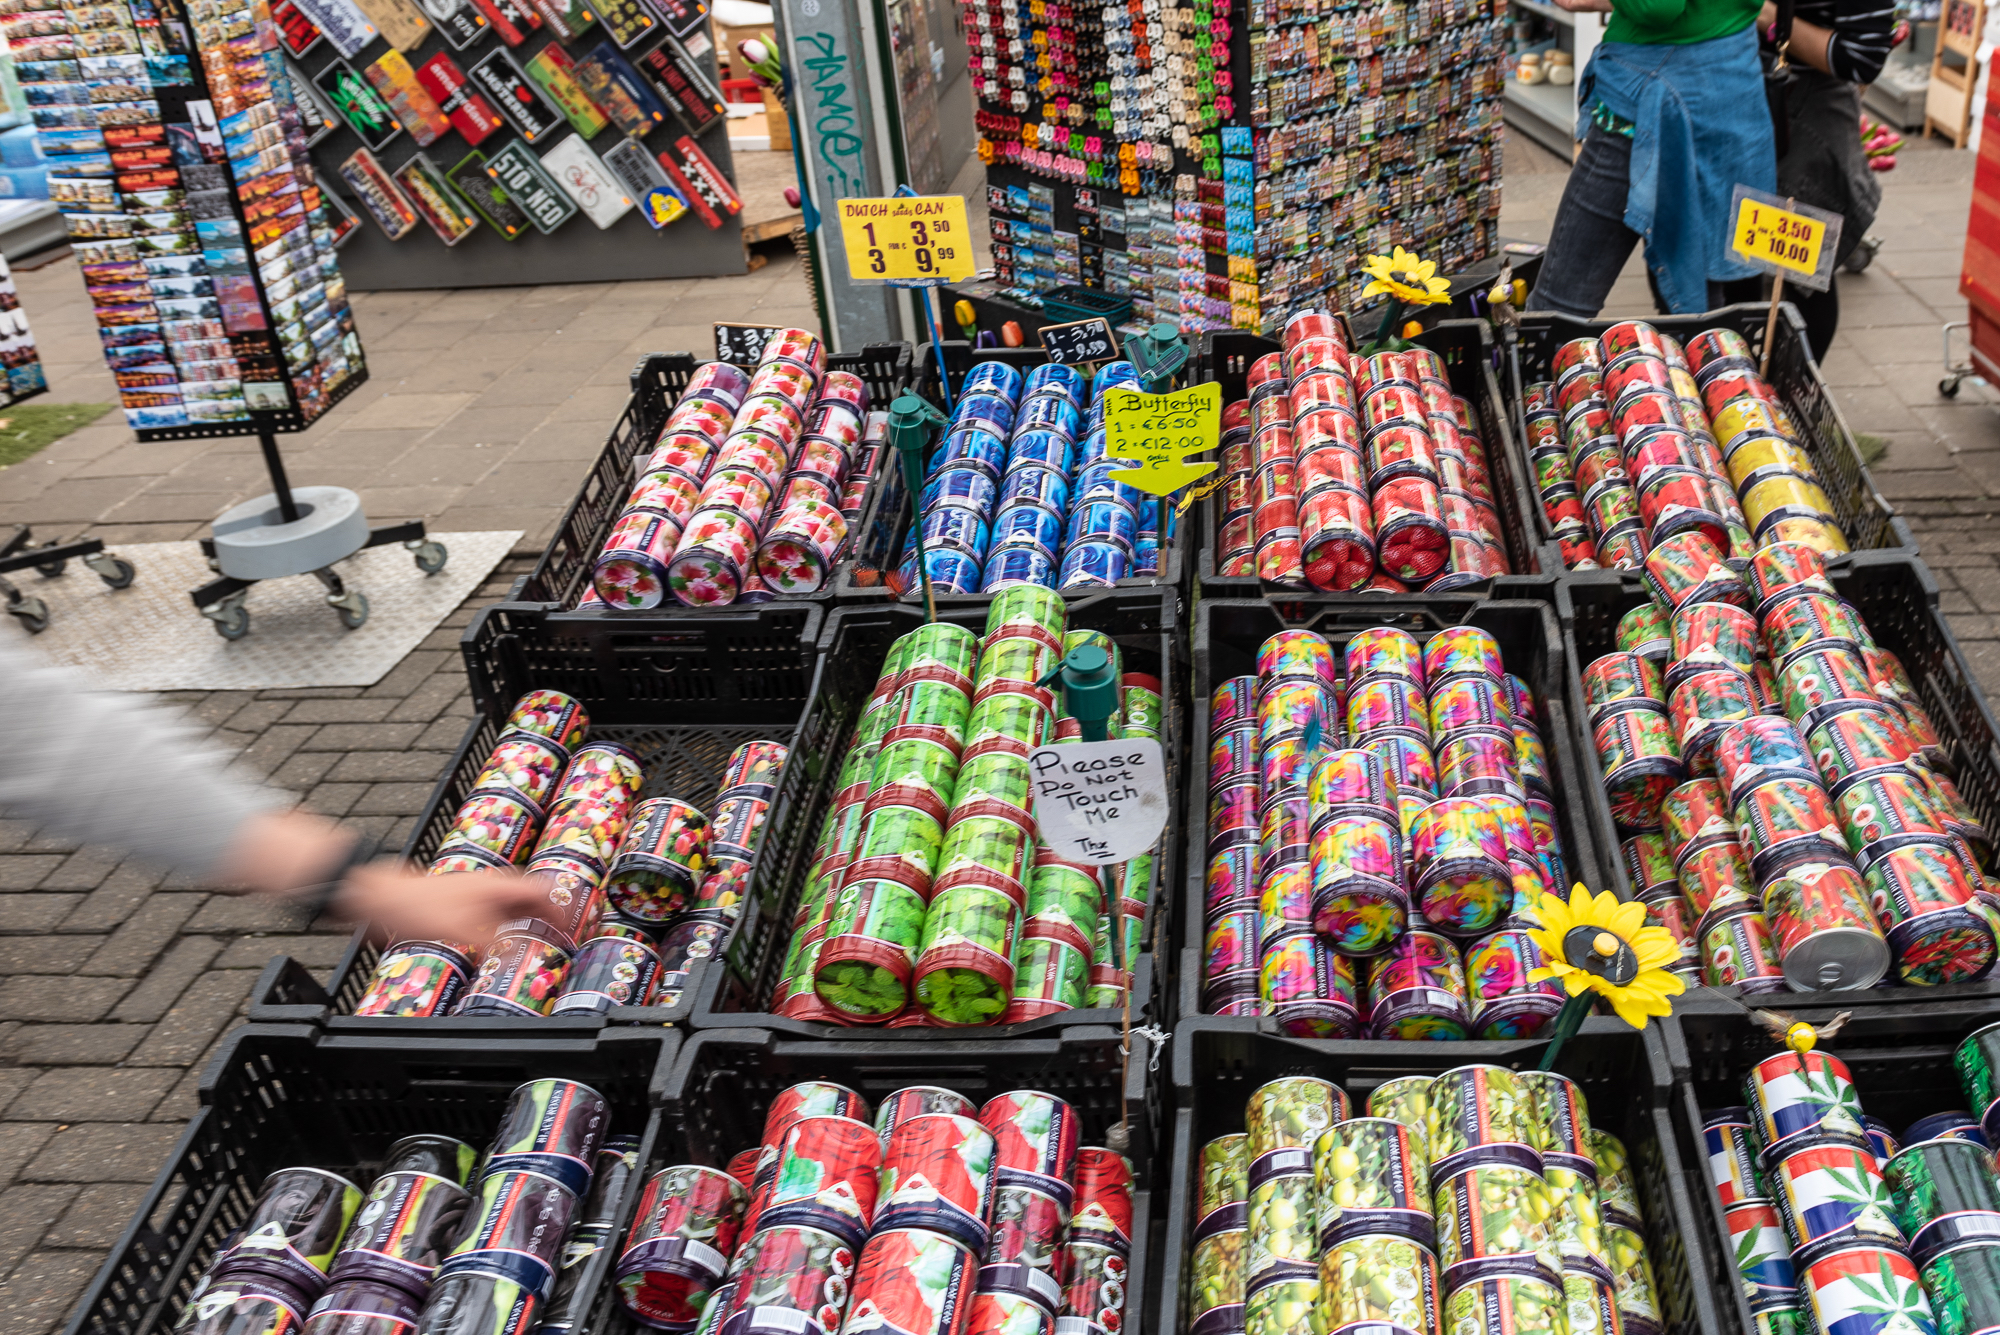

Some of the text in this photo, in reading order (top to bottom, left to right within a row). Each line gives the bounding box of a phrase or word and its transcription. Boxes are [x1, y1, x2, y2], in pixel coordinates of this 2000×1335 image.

[450, 12, 475, 38] 1275
[426, 60, 492, 134] amsterdam
[476, 63, 544, 136] AMSTERDAM
[845, 204, 888, 217] DUTCH
[915, 202, 944, 215] CAN
[863, 222, 876, 246] 1
[1752, 209, 1811, 241] 1 3,50
[869, 249, 885, 273] 3
[1746, 229, 1809, 263] 3 10,00
[1118, 394, 1211, 417] Butterfly
[1114, 422, 1123, 433] 1
[1116, 439, 1127, 451] 2
[1030, 751, 1145, 776] Please
[1036, 770, 1134, 796] Do Not
[1055, 785, 1138, 810] Touch
[1084, 807, 1120, 824] Me
[1074, 837, 1109, 852] Thx
[1463, 1078, 1477, 1133] OLIVE TREE
[1559, 1089, 1573, 1141] OLIVE TREE
[1044, 1112, 1063, 1160] RED ROSES
[1388, 1134, 1403, 1194] OLIVE TREE
[374, 1211, 397, 1245] BLACK
[389, 1179, 413, 1214] ROSES
[477, 1209, 500, 1242] BLACK
[492, 1178, 515, 1212] ROSES
[1456, 1185, 1470, 1245] OLIVE TREE
[941, 1262, 963, 1325] RED ROSES
[1485, 1291, 1498, 1321] TREE
